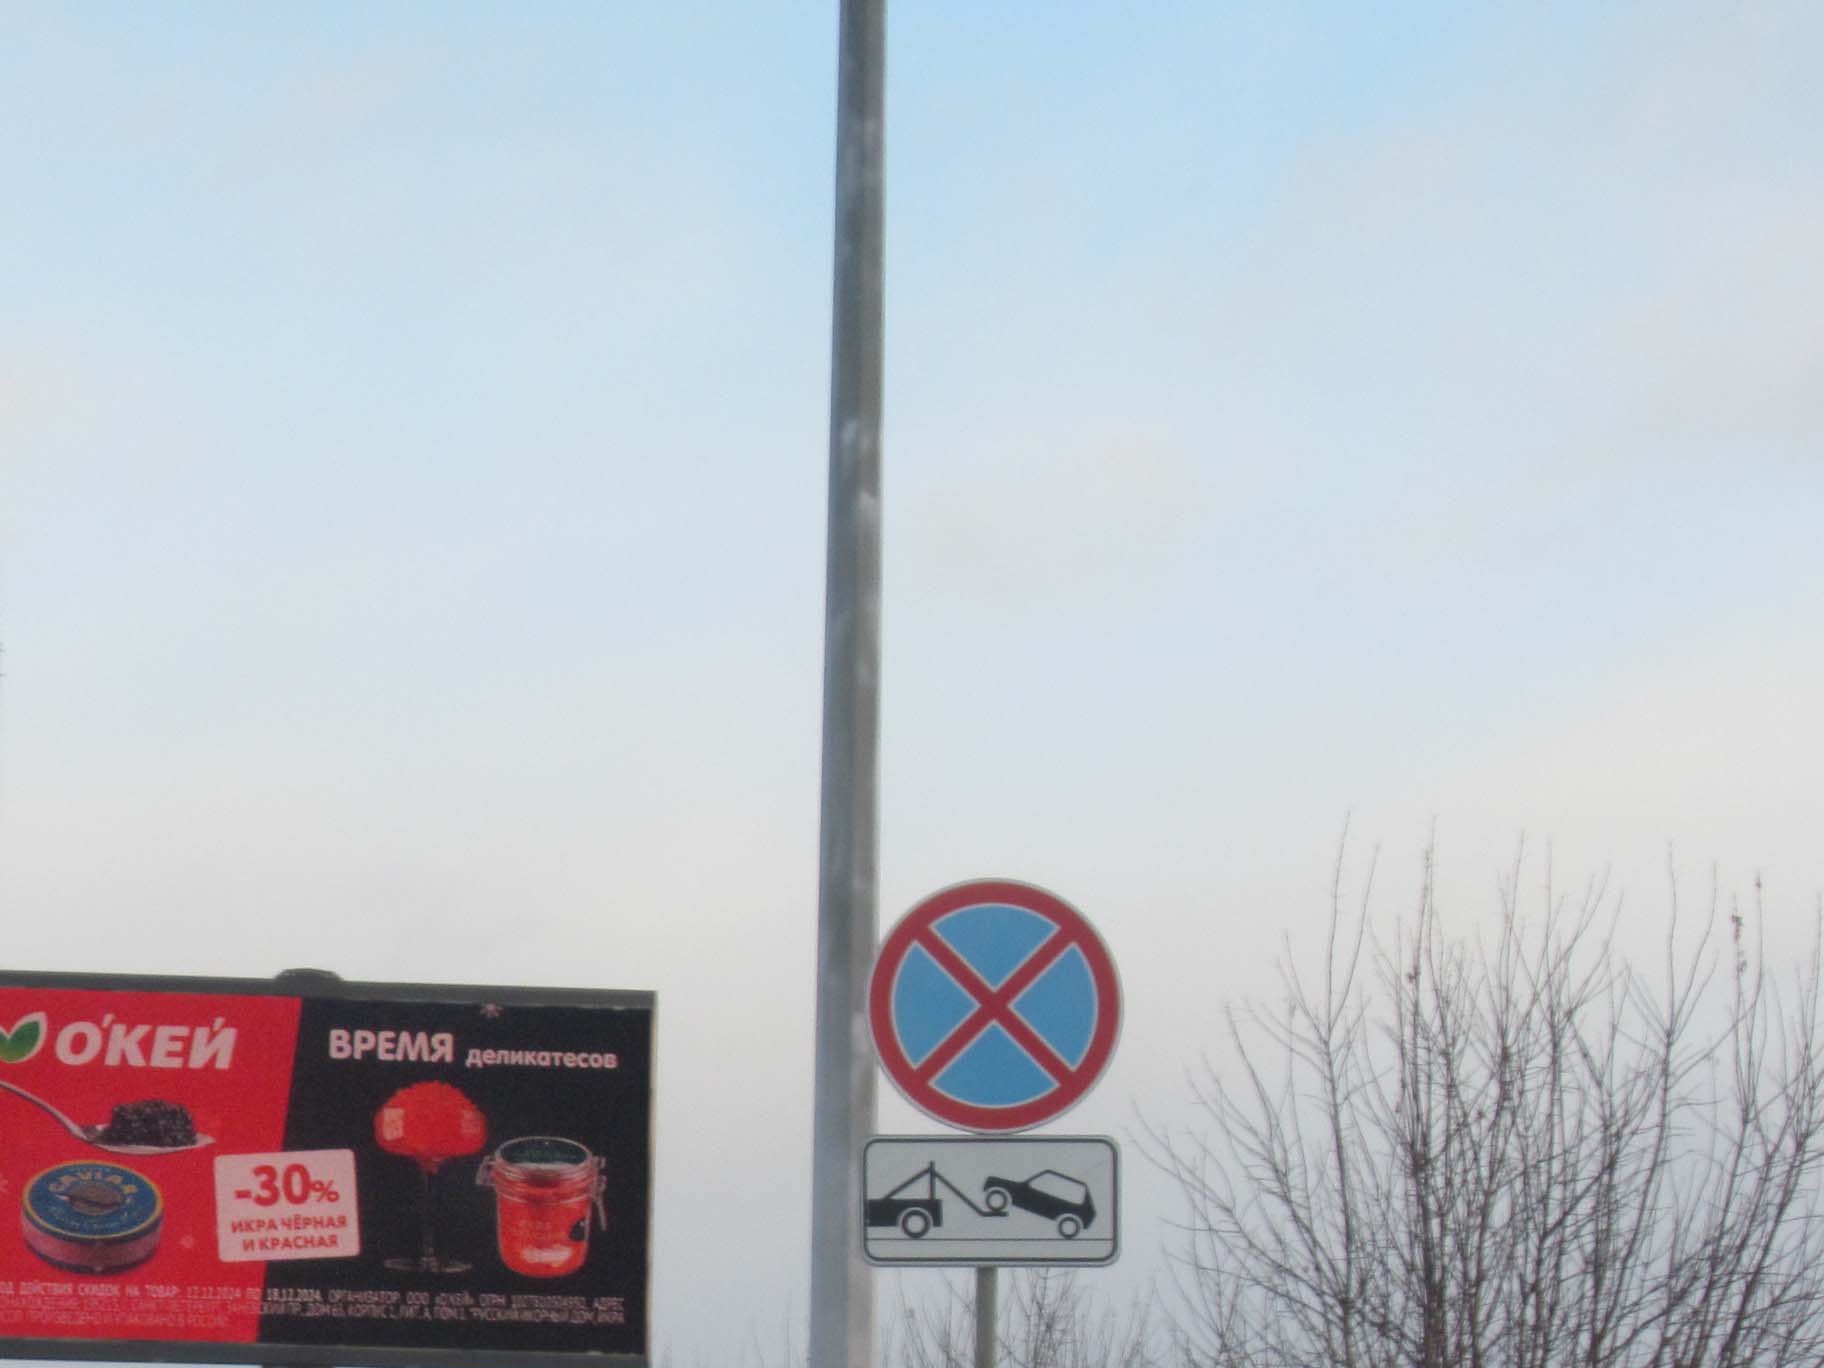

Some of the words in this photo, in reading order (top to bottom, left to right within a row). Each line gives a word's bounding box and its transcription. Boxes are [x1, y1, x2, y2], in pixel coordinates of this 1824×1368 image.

[55, 1013, 238, 1069] О'КЕЙ
[329, 1029, 454, 1063] ВРЕМЯ
[465, 1048, 619, 1069] деликатесов
[234, 1163, 340, 1207] -30%
[231, 1218, 278, 1233] ИКРА
[280, 1214, 348, 1231] ЧЁРНАЯ
[242, 1239, 255, 1252] И
[259, 1235, 339, 1251] КРАСНАЯ
